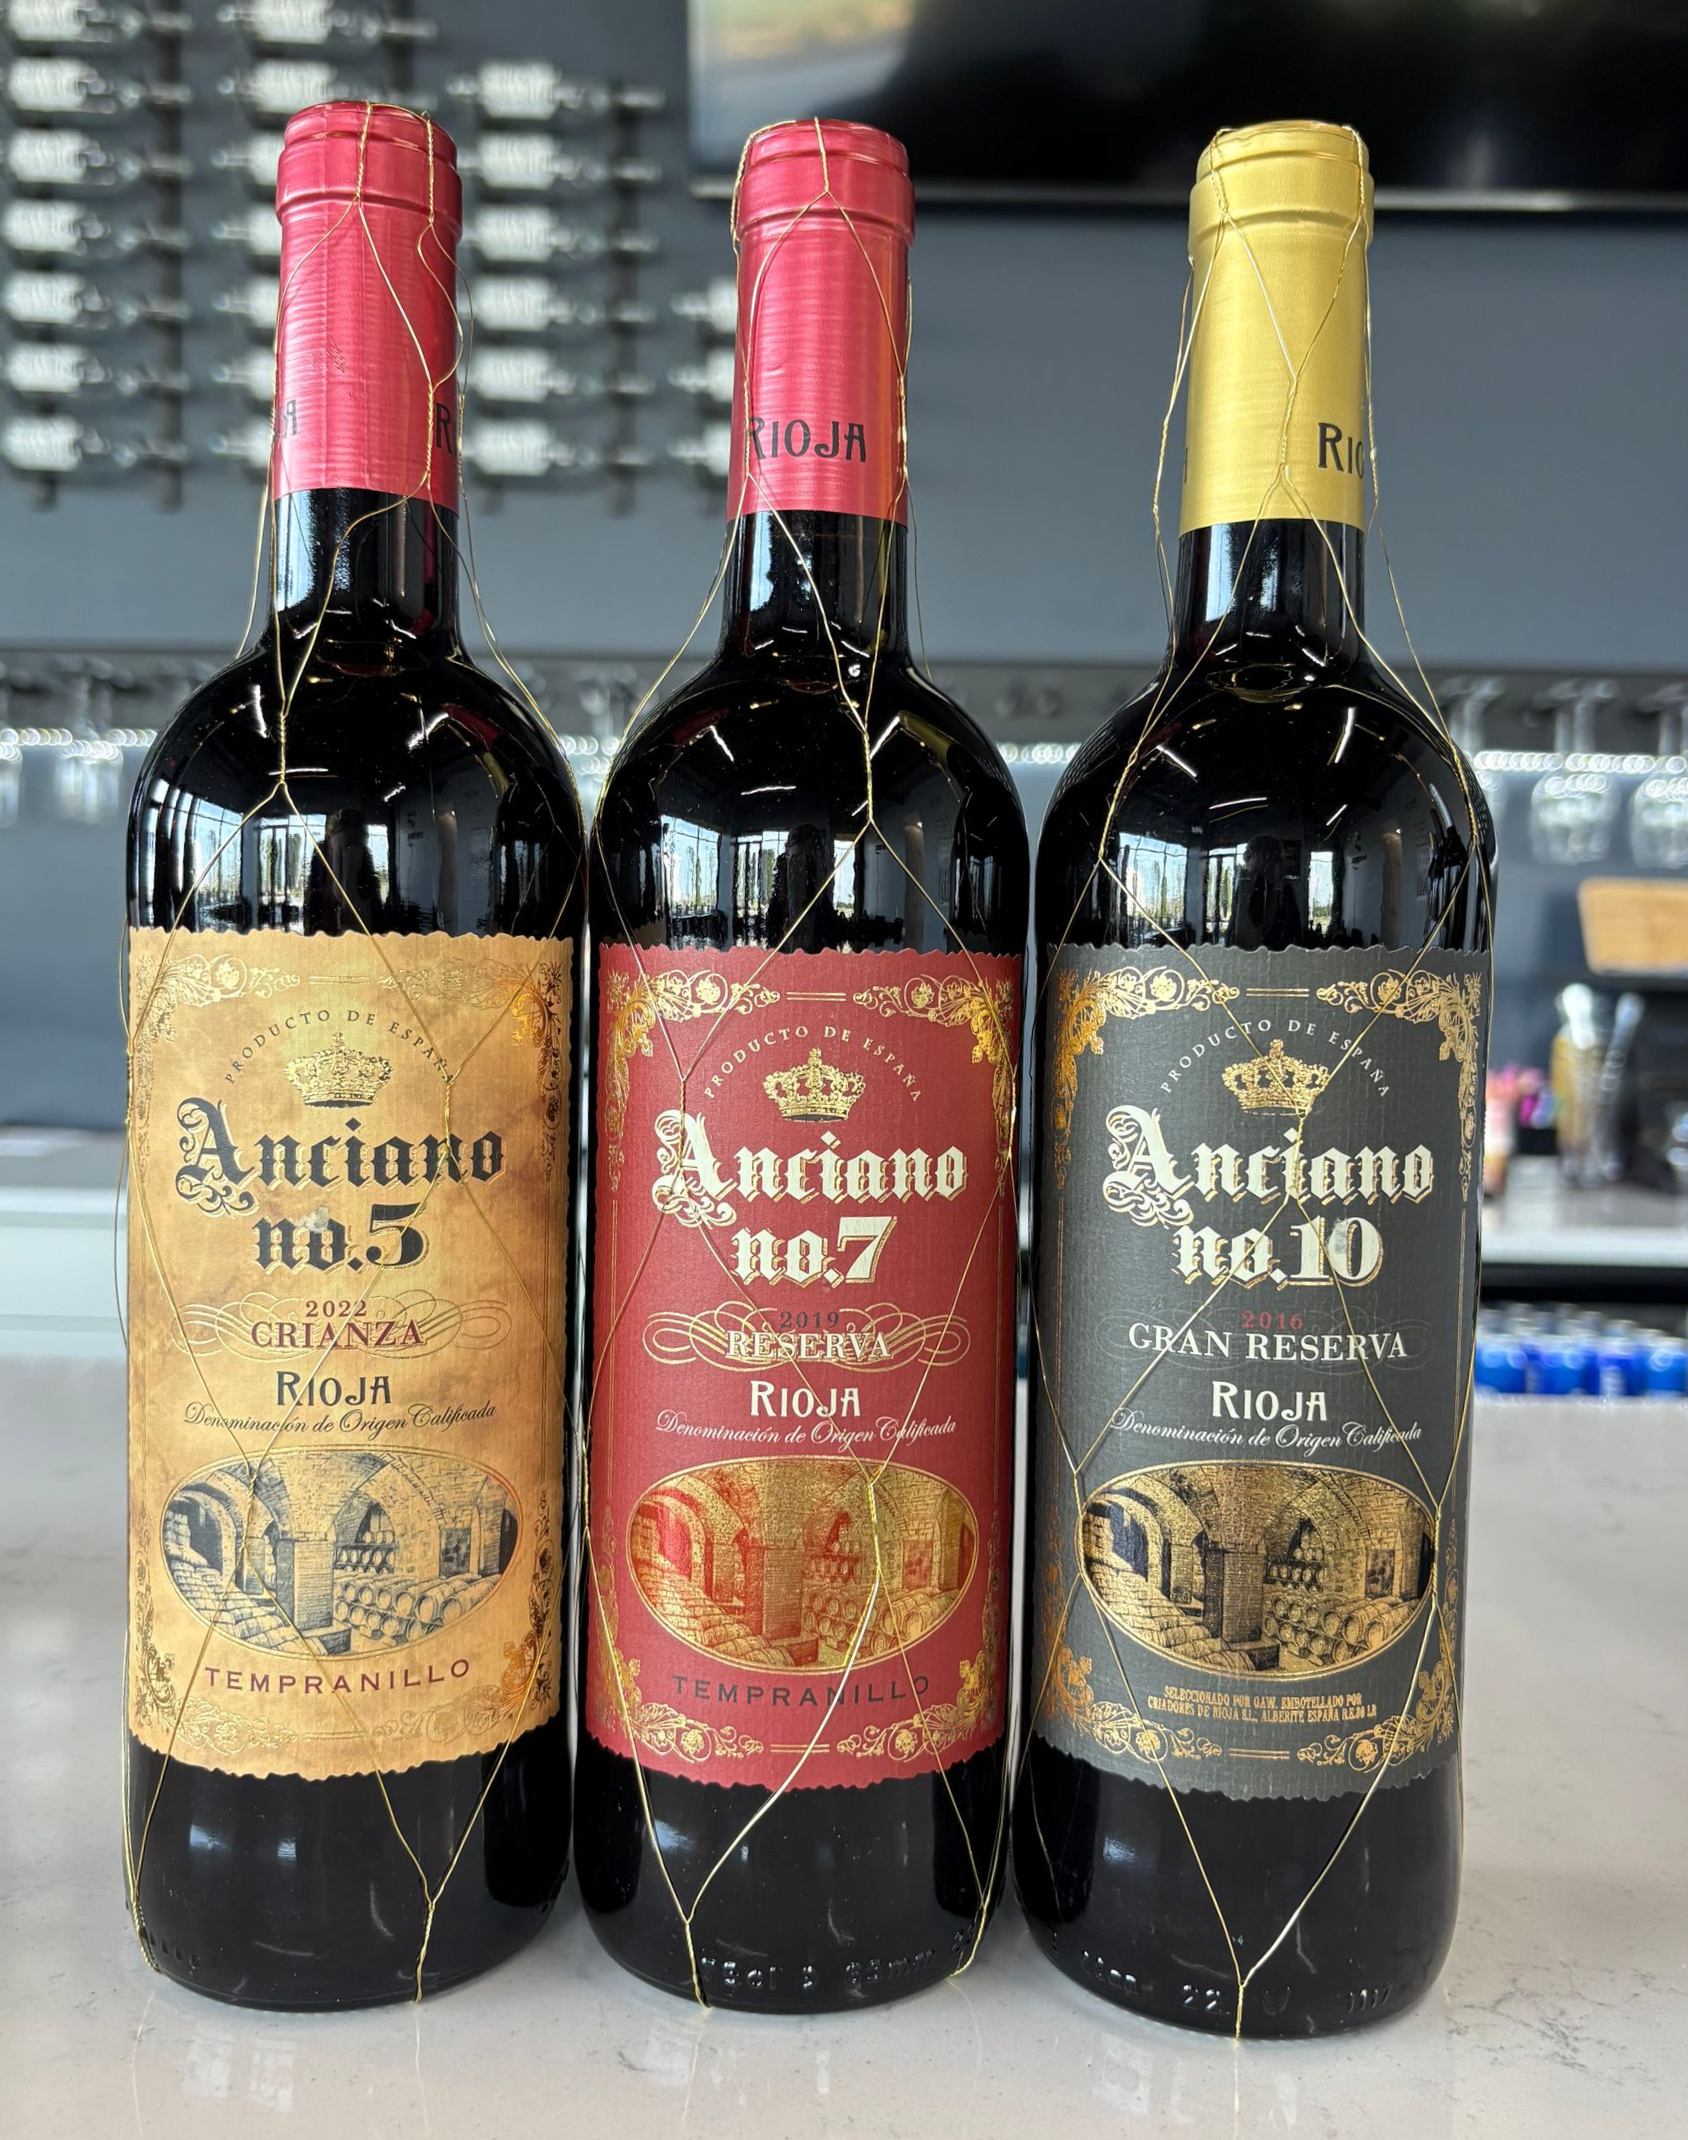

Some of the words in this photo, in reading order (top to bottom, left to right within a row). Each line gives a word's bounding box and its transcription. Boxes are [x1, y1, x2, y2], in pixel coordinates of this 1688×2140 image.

[748, 416, 867, 463] RIOJA
[225, 1010, 330, 1083] PRODUCTO
[347, 1010, 376, 1025] DE
[704, 1026, 808, 1099] PRODUCTO
[824, 1026, 851, 1042] DE
[862, 1037, 922, 1102] ESPAÑA
[1160, 1020, 1272, 1093] PRODUCTO
[1288, 1020, 1316, 1036] DE
[1328, 1031, 1390, 1097] ESPAÑA
[175, 1097, 505, 1217] Anciano
[651, 1109, 968, 1228] Anciano
[1103, 1104, 1434, 1228] Anciano
[253, 1202, 428, 1274] no.5
[731, 1216, 897, 1287] no.7
[1173, 1215, 1384, 1289] no.10
[306, 1300, 368, 1317] 2022
[780, 1311, 840, 1330] 2019
[1240, 1310, 1303, 1330] 2016
[251, 1320, 426, 1348] CRIANZA
[724, 1329, 894, 1361] RESERVA
[1128, 1322, 1232, 1358] GRAN
[1245, 1332, 1408, 1362] RESERVA
[277, 1371, 391, 1406] RIOJA
[750, 1380, 861, 1417] RIOJA
[1211, 1380, 1327, 1421] RIOJA
[184, 1401, 308, 1433] Denominación
[312, 1413, 333, 1432] de
[339, 1409, 407, 1440] Origen
[408, 1400, 496, 1431] Calificada
[656, 1409, 781, 1443] Denominación
[784, 1425, 806, 1444] de
[810, 1420, 875, 1452] Origen
[875, 1415, 957, 1446] Calificada
[1111, 1407, 1245, 1445] Denominación
[1248, 1426, 1270, 1446] de
[1275, 1424, 1342, 1457] Origen
[1342, 1421, 1422, 1452] Calificada
[204, 1660, 470, 1694] TEMPRANILLO
[671, 1674, 930, 1708] TEMPRANILLO
[1148, 1695, 1194, 1716] CRIADORES
[1197, 1705, 1210, 1717] DE
[1213, 1705, 1239, 1719] RIOJA
[1261, 1708, 1306, 1723] ALBERITE
[1164, 1685, 1229, 1708] SELECCIONADO
[1232, 1694, 1250, 1708] POR
[1281, 1694, 1343, 1710] EMBOTELLADO
[1346, 1692, 1362, 1706] POR
